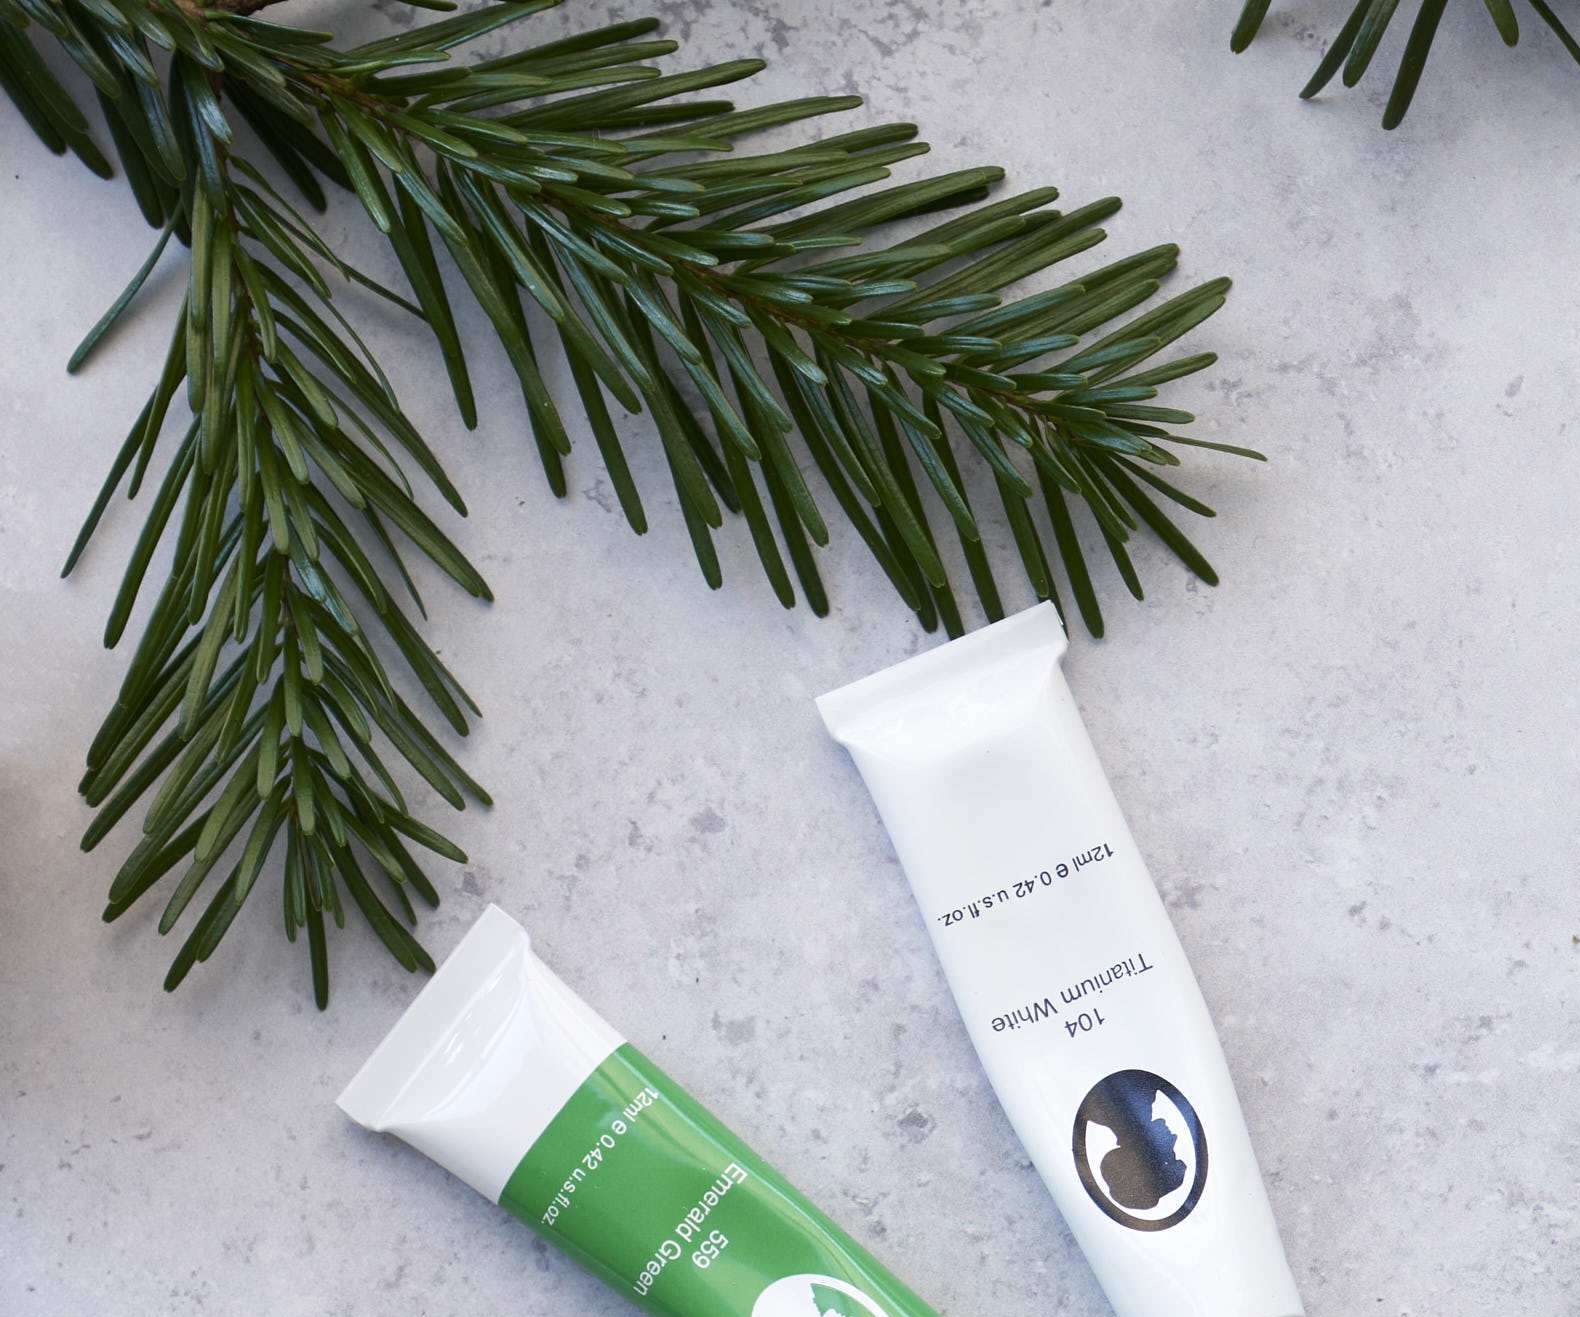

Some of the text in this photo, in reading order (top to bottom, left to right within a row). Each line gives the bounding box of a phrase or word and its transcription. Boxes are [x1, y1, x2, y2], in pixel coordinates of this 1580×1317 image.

[1071, 842, 1114, 872] 12ml
[1012, 870, 1052, 898] 0.42
[937, 889, 1010, 927] u.s.fl.oz.
[991, 952, 1154, 1032] Titanium White
[1064, 1007, 1106, 1038] 104
[622, 1087, 659, 1124] 12ml
[581, 1133, 616, 1171] 0.42
[541, 1167, 587, 1227] u.s.fl.oz.
[633, 1162, 748, 1297] Emerald Green
[691, 1229, 729, 1269] 559
